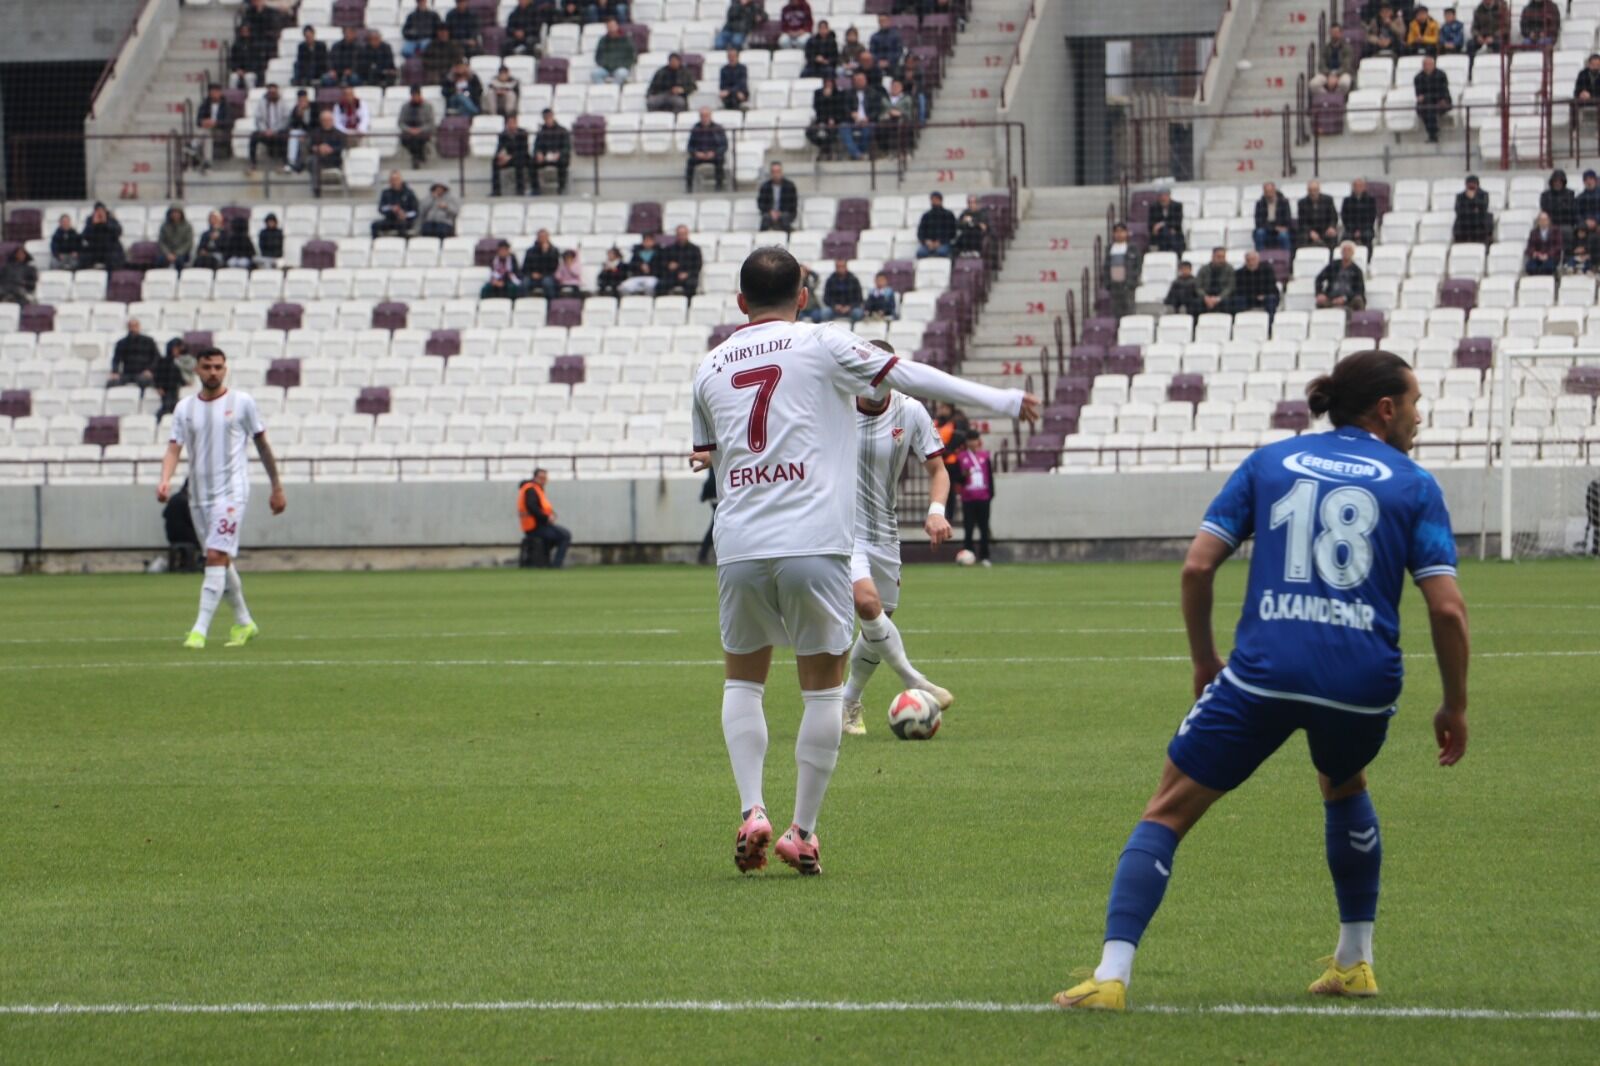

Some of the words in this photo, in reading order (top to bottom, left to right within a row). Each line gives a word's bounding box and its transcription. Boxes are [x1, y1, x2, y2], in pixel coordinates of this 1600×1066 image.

[1278, 46, 1296, 57] 17
[1245, 138, 1264, 149] 20
[946, 147, 966, 160] 20
[132, 162, 151, 173] 20
[1236, 159, 1255, 171] 21
[937, 170, 956, 182] 21
[1050, 239, 1070, 251] 22
[1026, 302, 1046, 315] 24
[1015, 335, 1035, 347] 25
[1001, 361, 1024, 375] 26
[731, 364, 783, 453] 7
[1301, 453, 1377, 476] ERBETON
[729, 461, 805, 488] ERKAN
[217, 518, 237, 535] 34
[1269, 478, 1380, 591] 18
[1259, 589, 1376, 631] Ö.KANDEMİR
